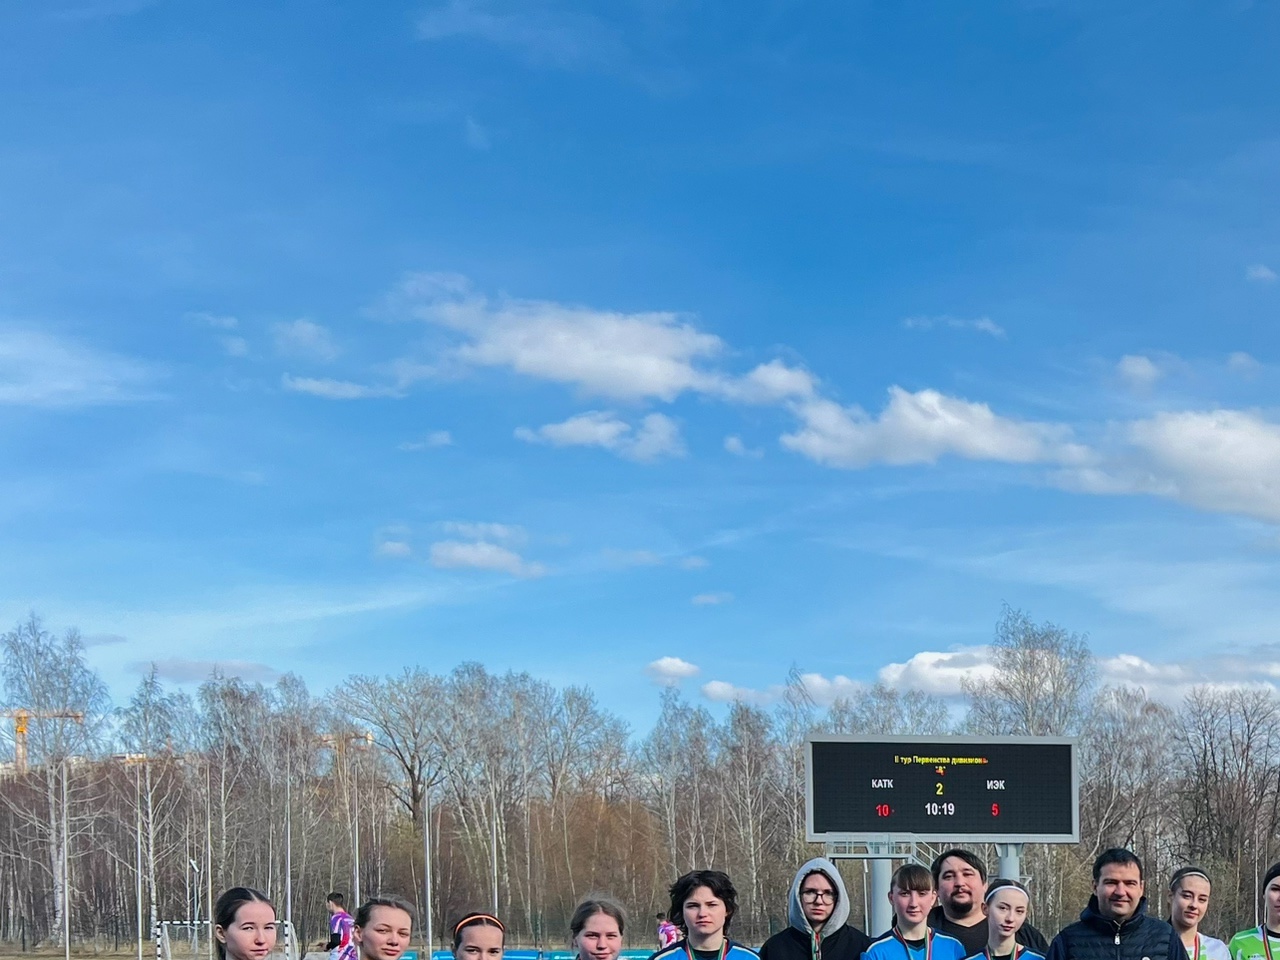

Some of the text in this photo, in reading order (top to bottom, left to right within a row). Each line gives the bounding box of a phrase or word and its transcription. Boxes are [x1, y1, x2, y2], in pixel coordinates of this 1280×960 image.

[871, 779, 894, 789] КАТК
[935, 782, 944, 795] 2
[986, 779, 1005, 790] ИЭК
[875, 804, 889, 817] 10
[925, 802, 955, 816] 10:19
[991, 803, 999, 816] 5
